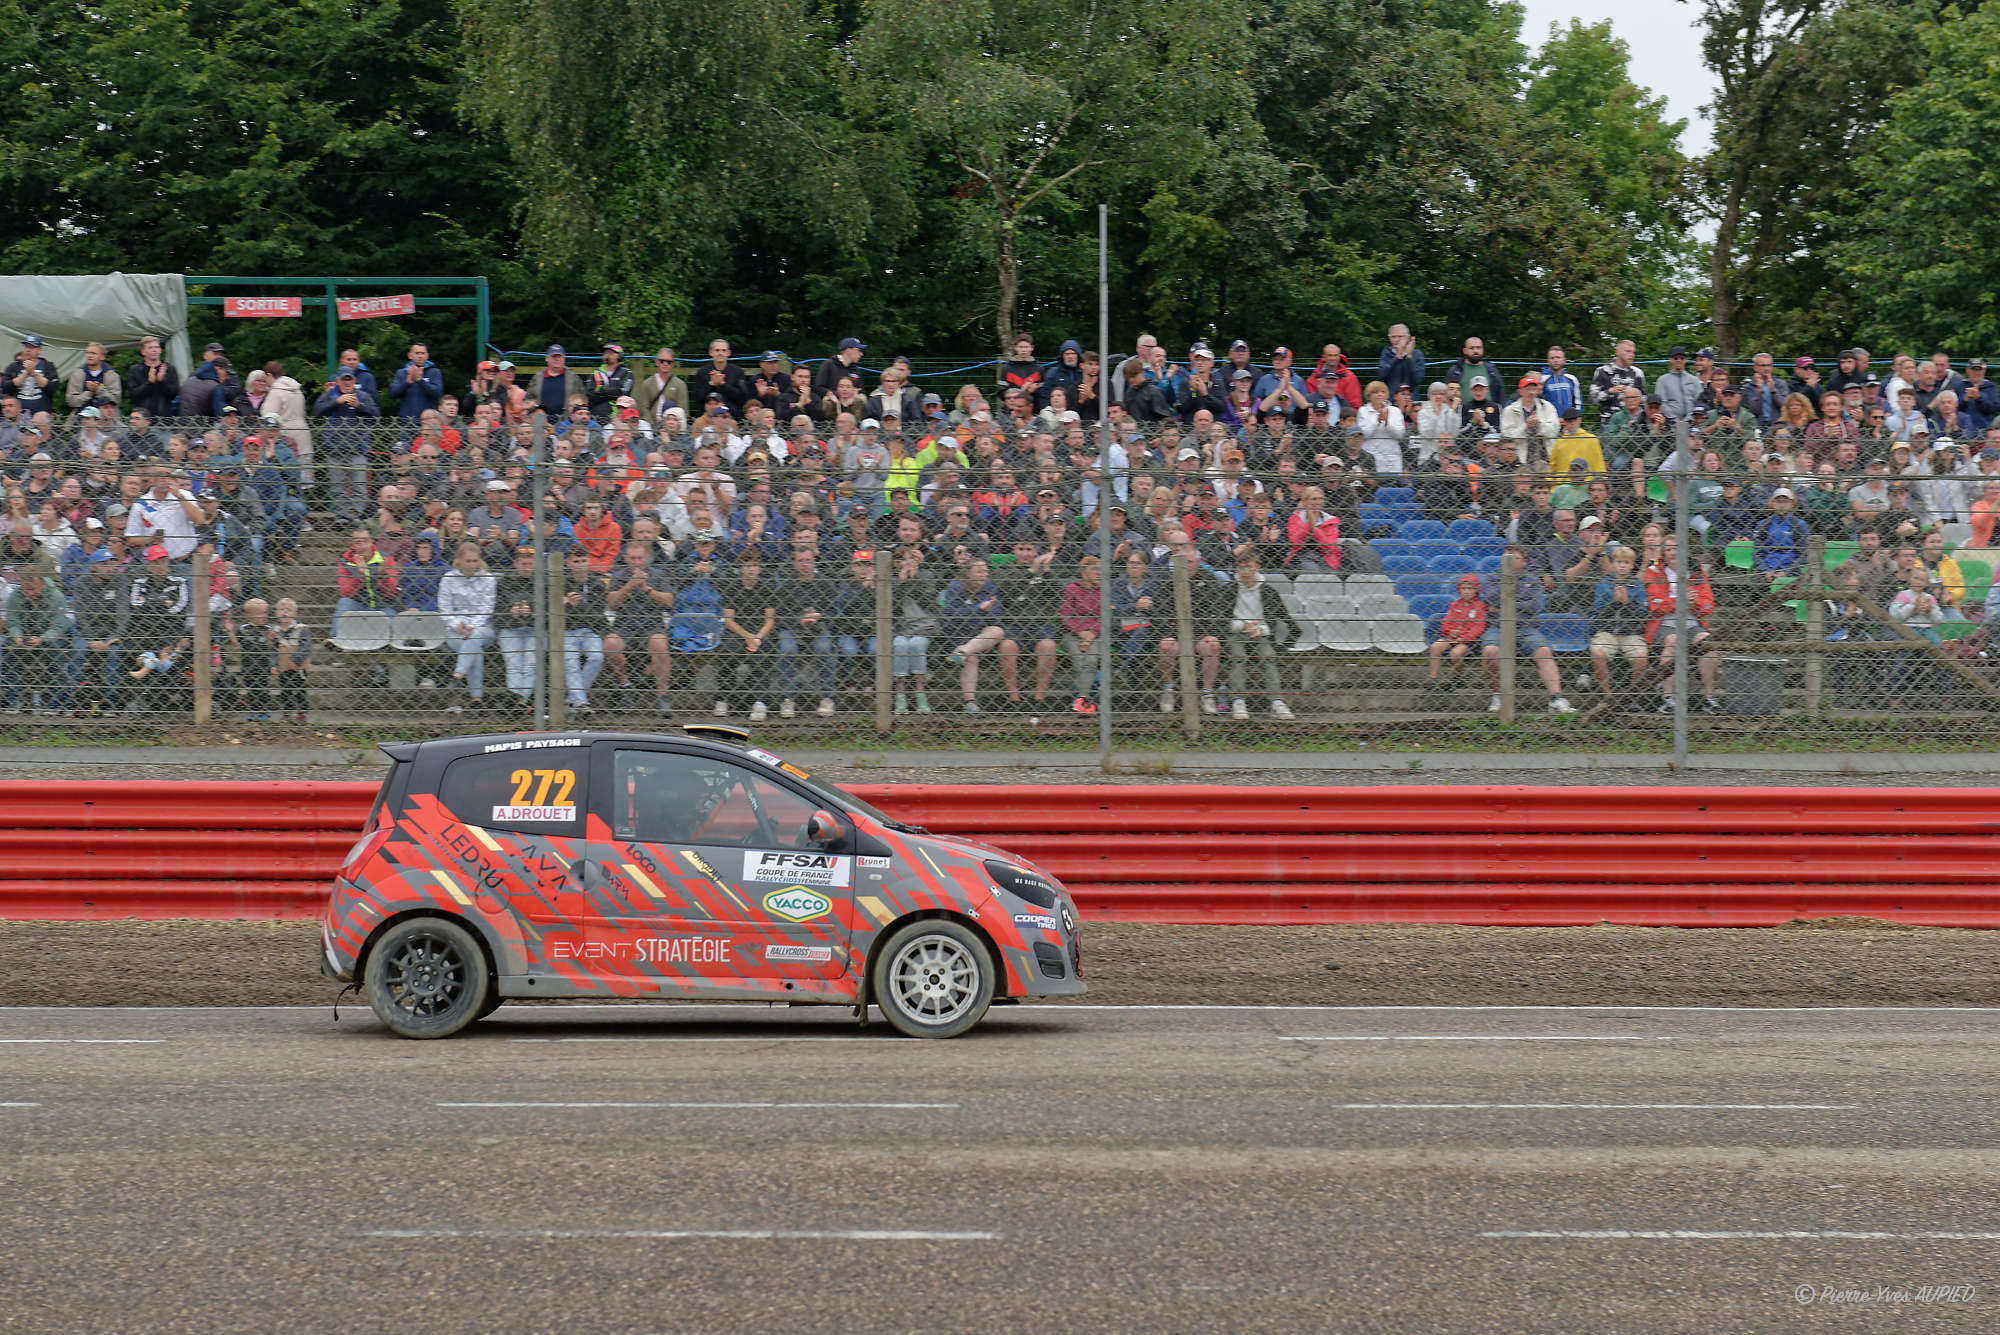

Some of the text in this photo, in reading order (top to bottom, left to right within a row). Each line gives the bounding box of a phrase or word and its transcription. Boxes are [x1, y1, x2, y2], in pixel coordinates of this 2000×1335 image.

[237, 299, 289, 310] SORTIE
[350, 298, 401, 313] SORTIE
[484, 738, 581, 753] MAPIS PAYSAGE
[509, 769, 576, 806] 272
[496, 808, 572, 819] A.DROUET
[440, 824, 504, 888] LEDRU
[625, 843, 656, 873] LOCO
[760, 853, 828, 868] FFSA
[756, 868, 785, 877] COUPE
[800, 871, 833, 879] FRANCE
[773, 897, 824, 910] YACCO
[1014, 914, 1056, 924] COOPER
[553, 941, 632, 958] EVENT
[770, 946, 809, 956] RALLYCROSS
